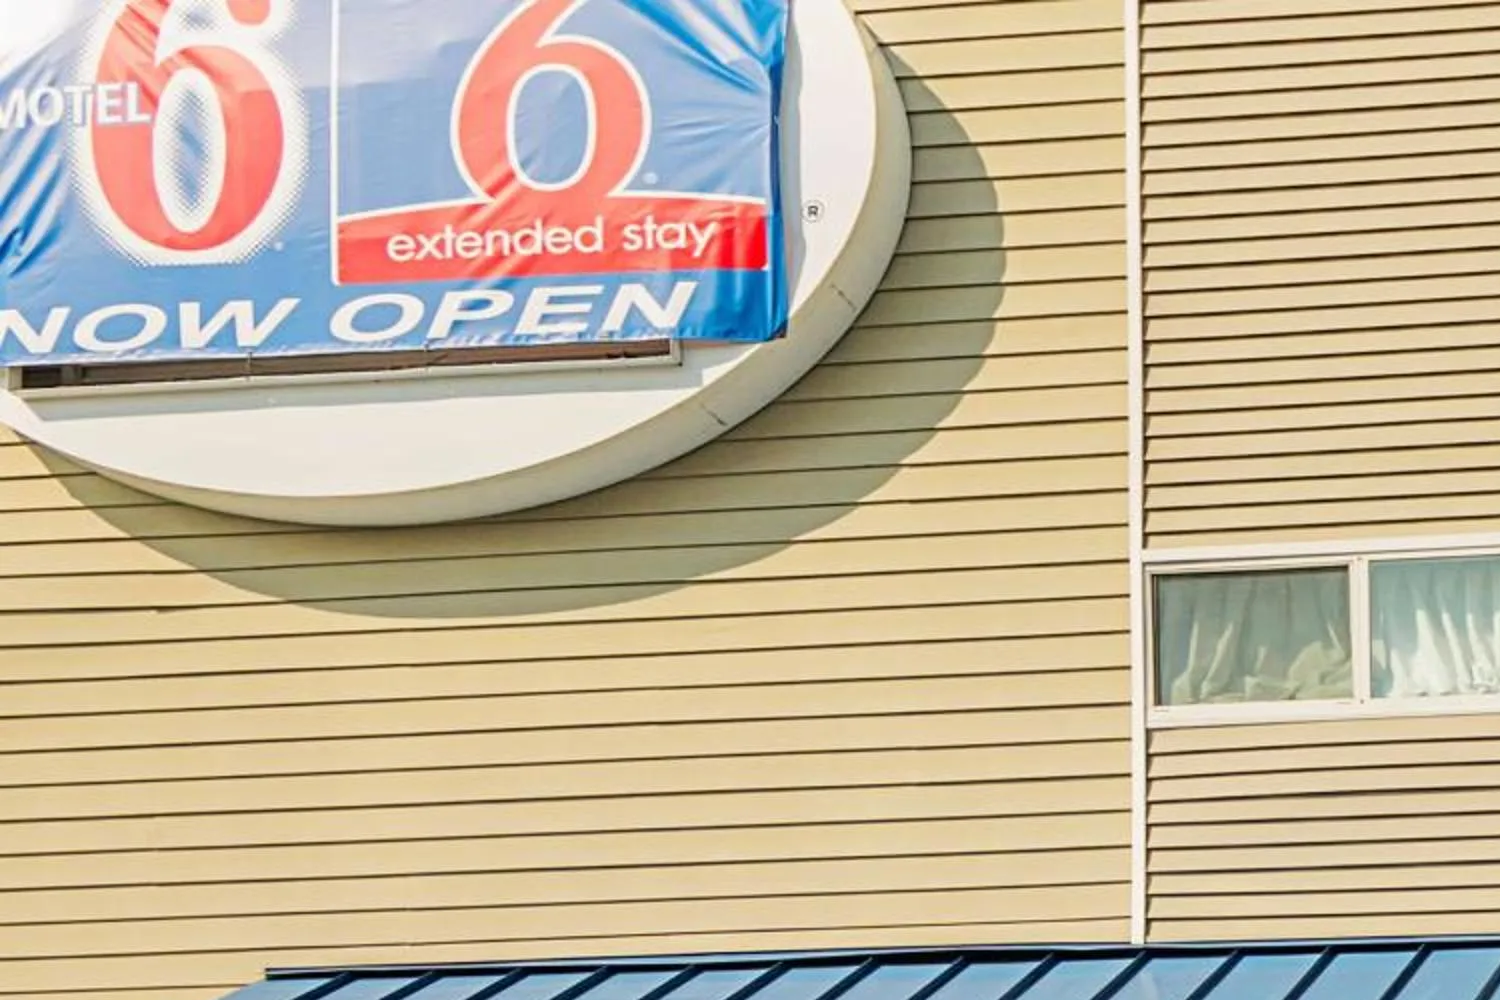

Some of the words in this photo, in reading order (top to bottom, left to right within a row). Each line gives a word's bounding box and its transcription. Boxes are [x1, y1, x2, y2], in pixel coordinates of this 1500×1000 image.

[0, 81, 152, 129] MOTEL
[90, 0, 286, 252] 6
[454, 0, 648, 199] 6
[387, 222, 603, 261] extended
[622, 217, 719, 256] stay
[0, 298, 302, 353] NOW
[329, 280, 698, 343] OPEN
